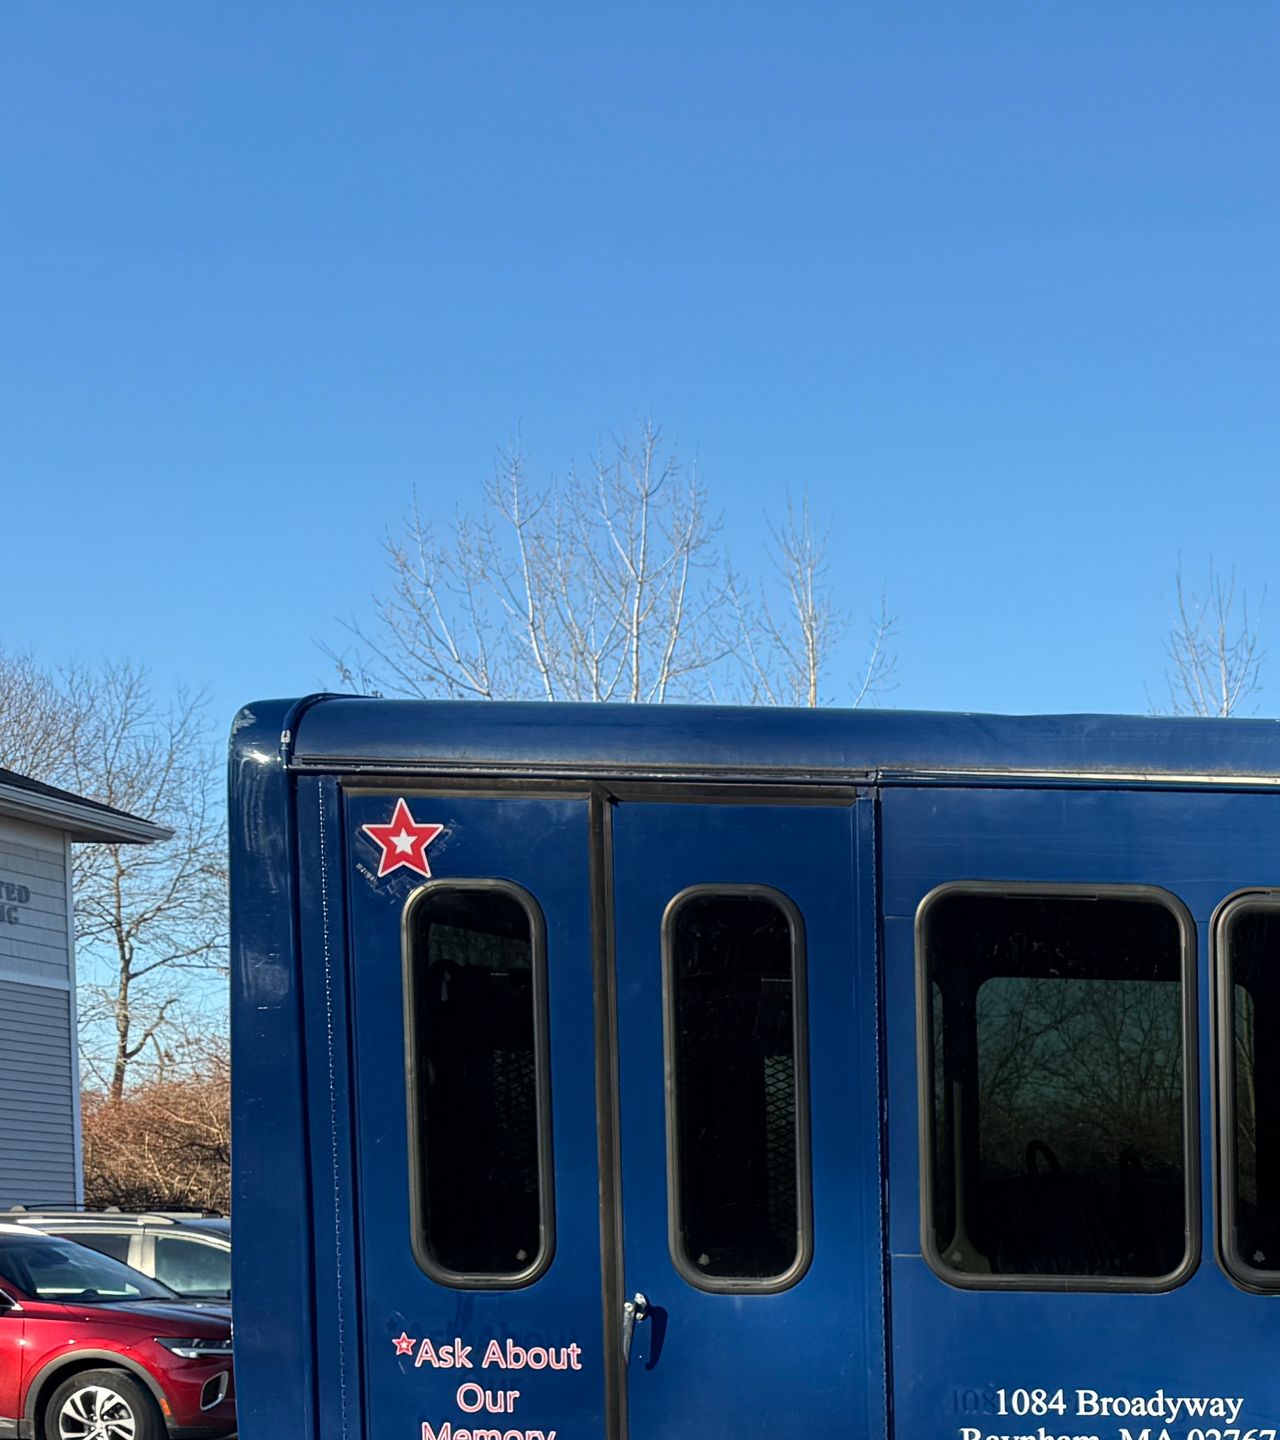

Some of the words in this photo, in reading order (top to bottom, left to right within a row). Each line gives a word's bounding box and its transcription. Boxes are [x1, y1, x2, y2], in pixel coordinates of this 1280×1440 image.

[416, 1337, 474, 1368] Ask
[481, 1338, 582, 1370] About
[456, 1382, 520, 1413] Our
[996, 1388, 1067, 1416] 1084
[1075, 1388, 1245, 1424] Broadyway
